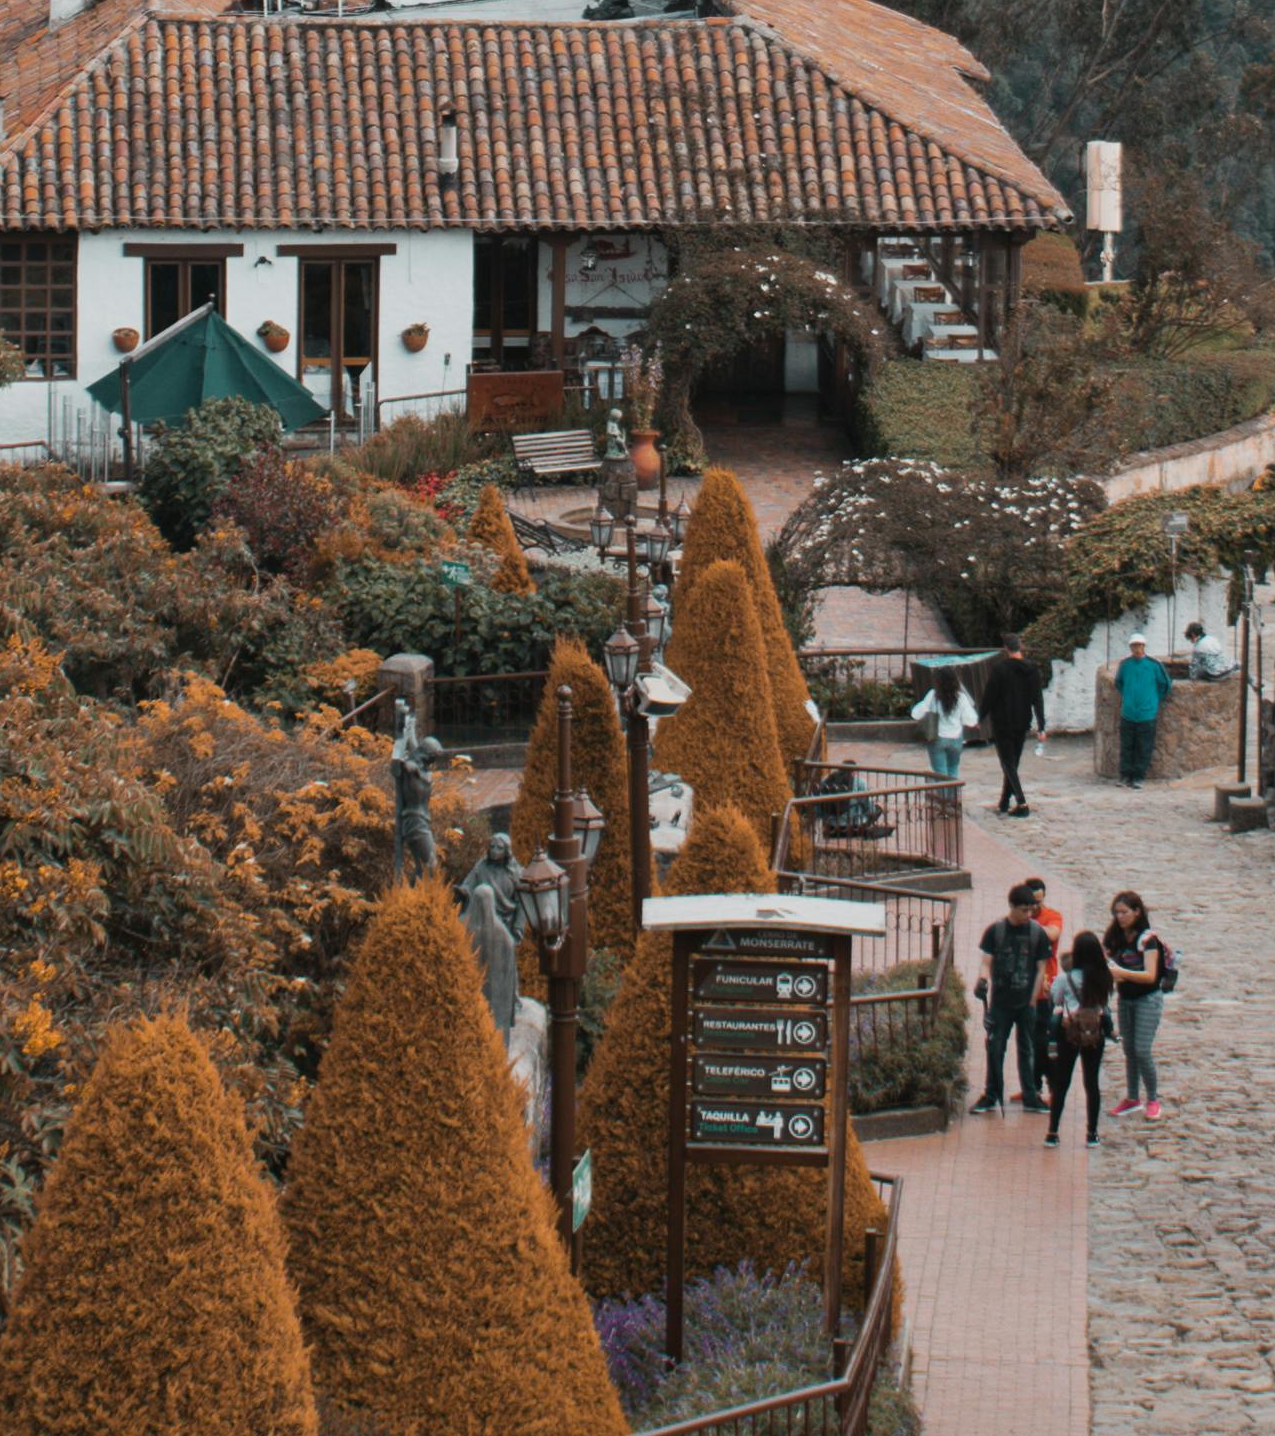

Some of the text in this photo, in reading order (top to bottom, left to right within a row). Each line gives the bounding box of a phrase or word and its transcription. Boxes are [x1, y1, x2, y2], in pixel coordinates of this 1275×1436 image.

[740, 937, 815, 951] MONSERRATE
[716, 974, 773, 986] FUNICULAR
[703, 1020, 776, 1032] RESTAURANTES
[705, 1065, 766, 1077] TELEFÉRICO
[700, 1110, 750, 1122] TAQUILLA
